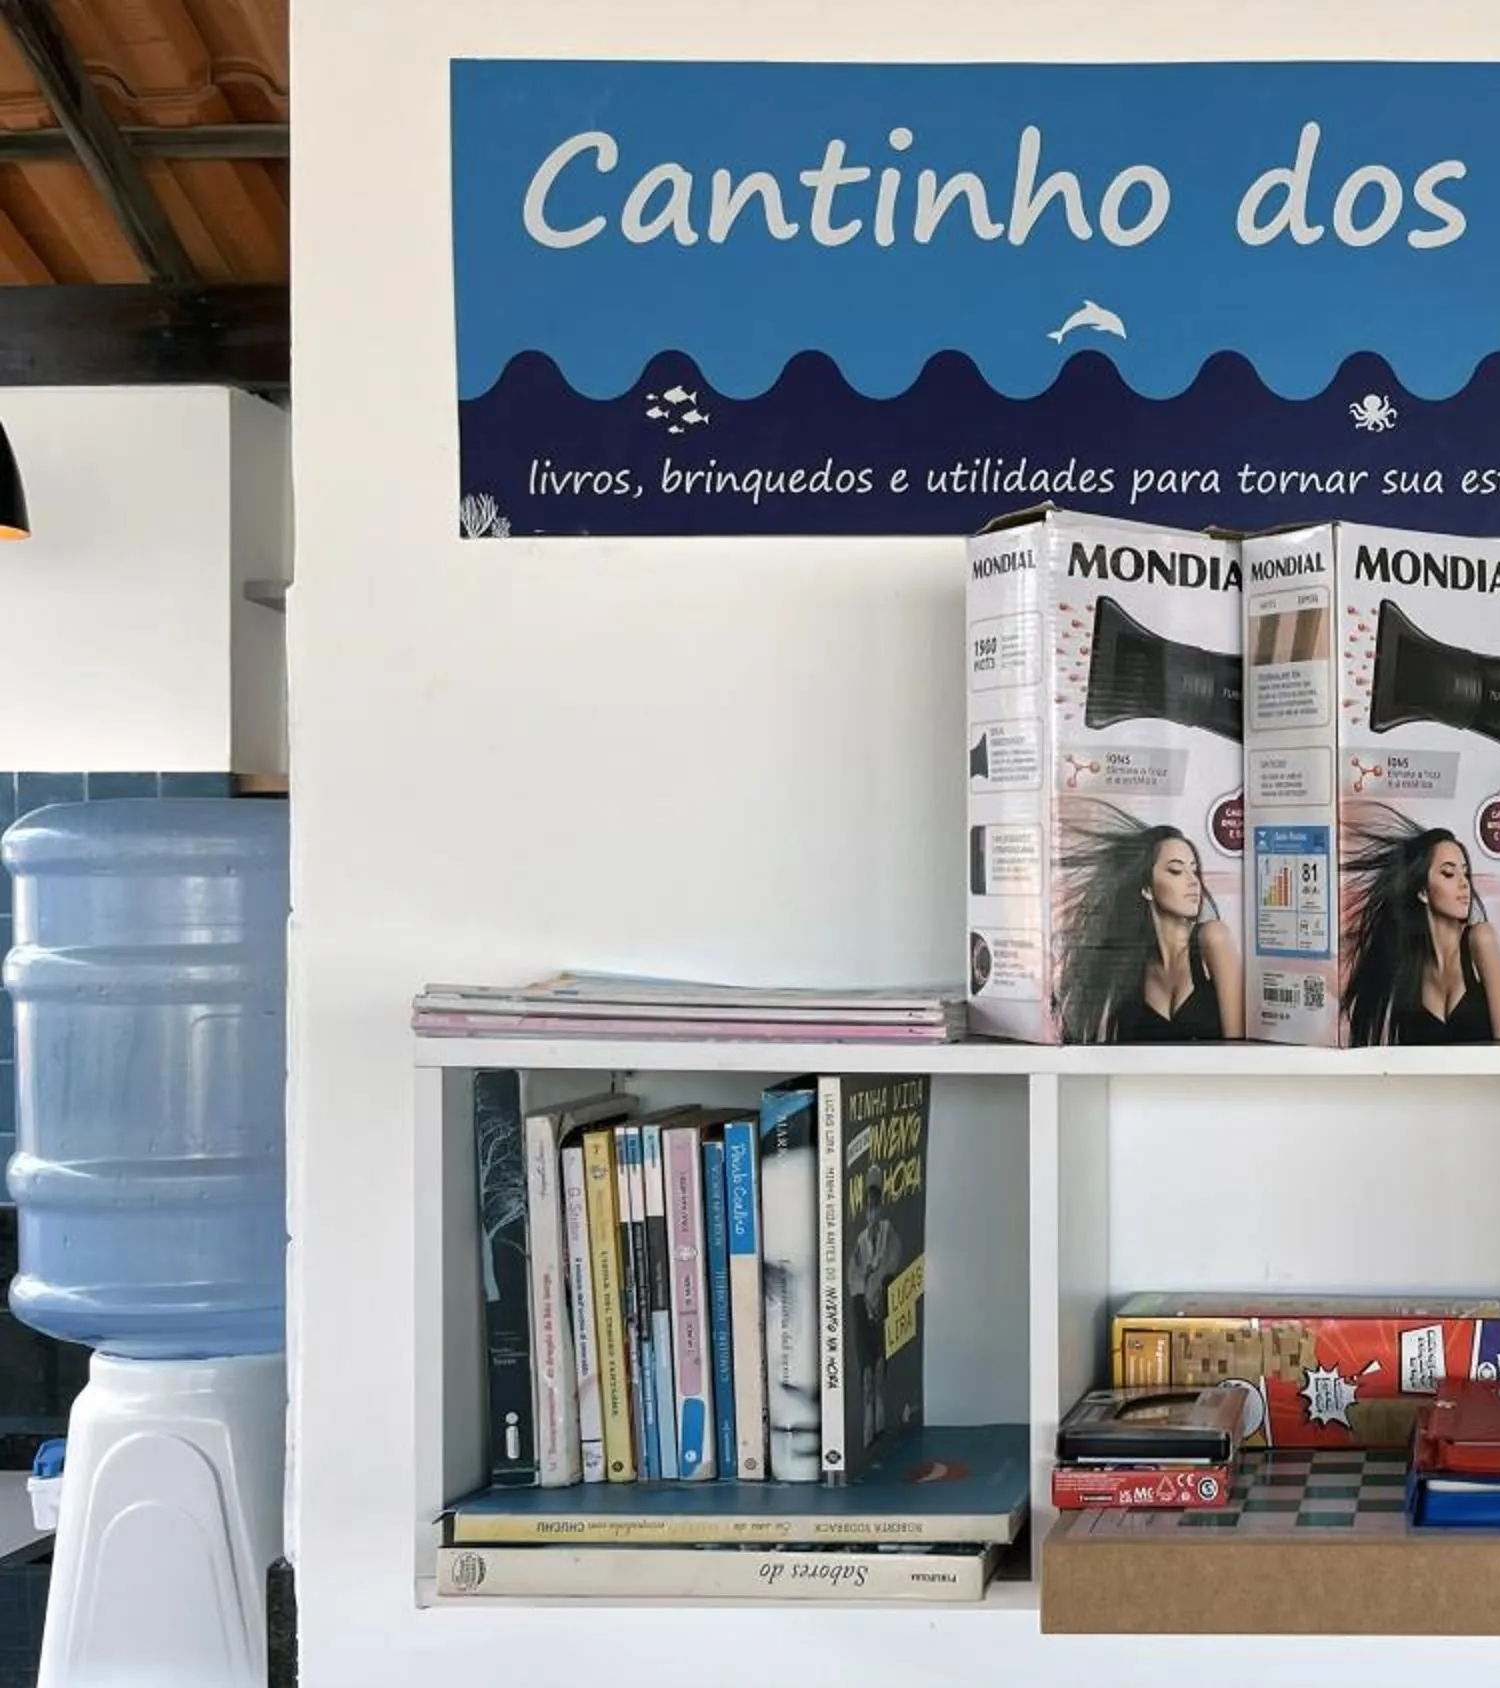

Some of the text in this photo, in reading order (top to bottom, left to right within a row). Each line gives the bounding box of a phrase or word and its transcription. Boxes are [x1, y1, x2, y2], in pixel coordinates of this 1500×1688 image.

[523, 125, 1173, 251] Cantinho
[1236, 121, 1469, 251] dos
[530, 460, 644, 499] livros,
[662, 458, 874, 506] brinquedos
[891, 470, 910, 494] e
[928, 458, 1116, 494] utilidades
[1131, 470, 1222, 506] para
[1238, 464, 1370, 495] tornar
[1382, 470, 1445, 496] sua
[972, 549, 1036, 580] MONDIAL
[1251, 551, 1326, 582] MONDIAL
[824, 1093, 835, 1127] LUCAS
[849, 1077, 923, 1122] MINHA VIDA
[731, 1143, 749, 1235] Paulo Coelho
[825, 1167, 837, 1201] MINHA
[824, 1356, 838, 1390] HORA
[536, 1521, 586, 1533] CHUCHU
[759, 1564, 869, 1587] Sabores do
